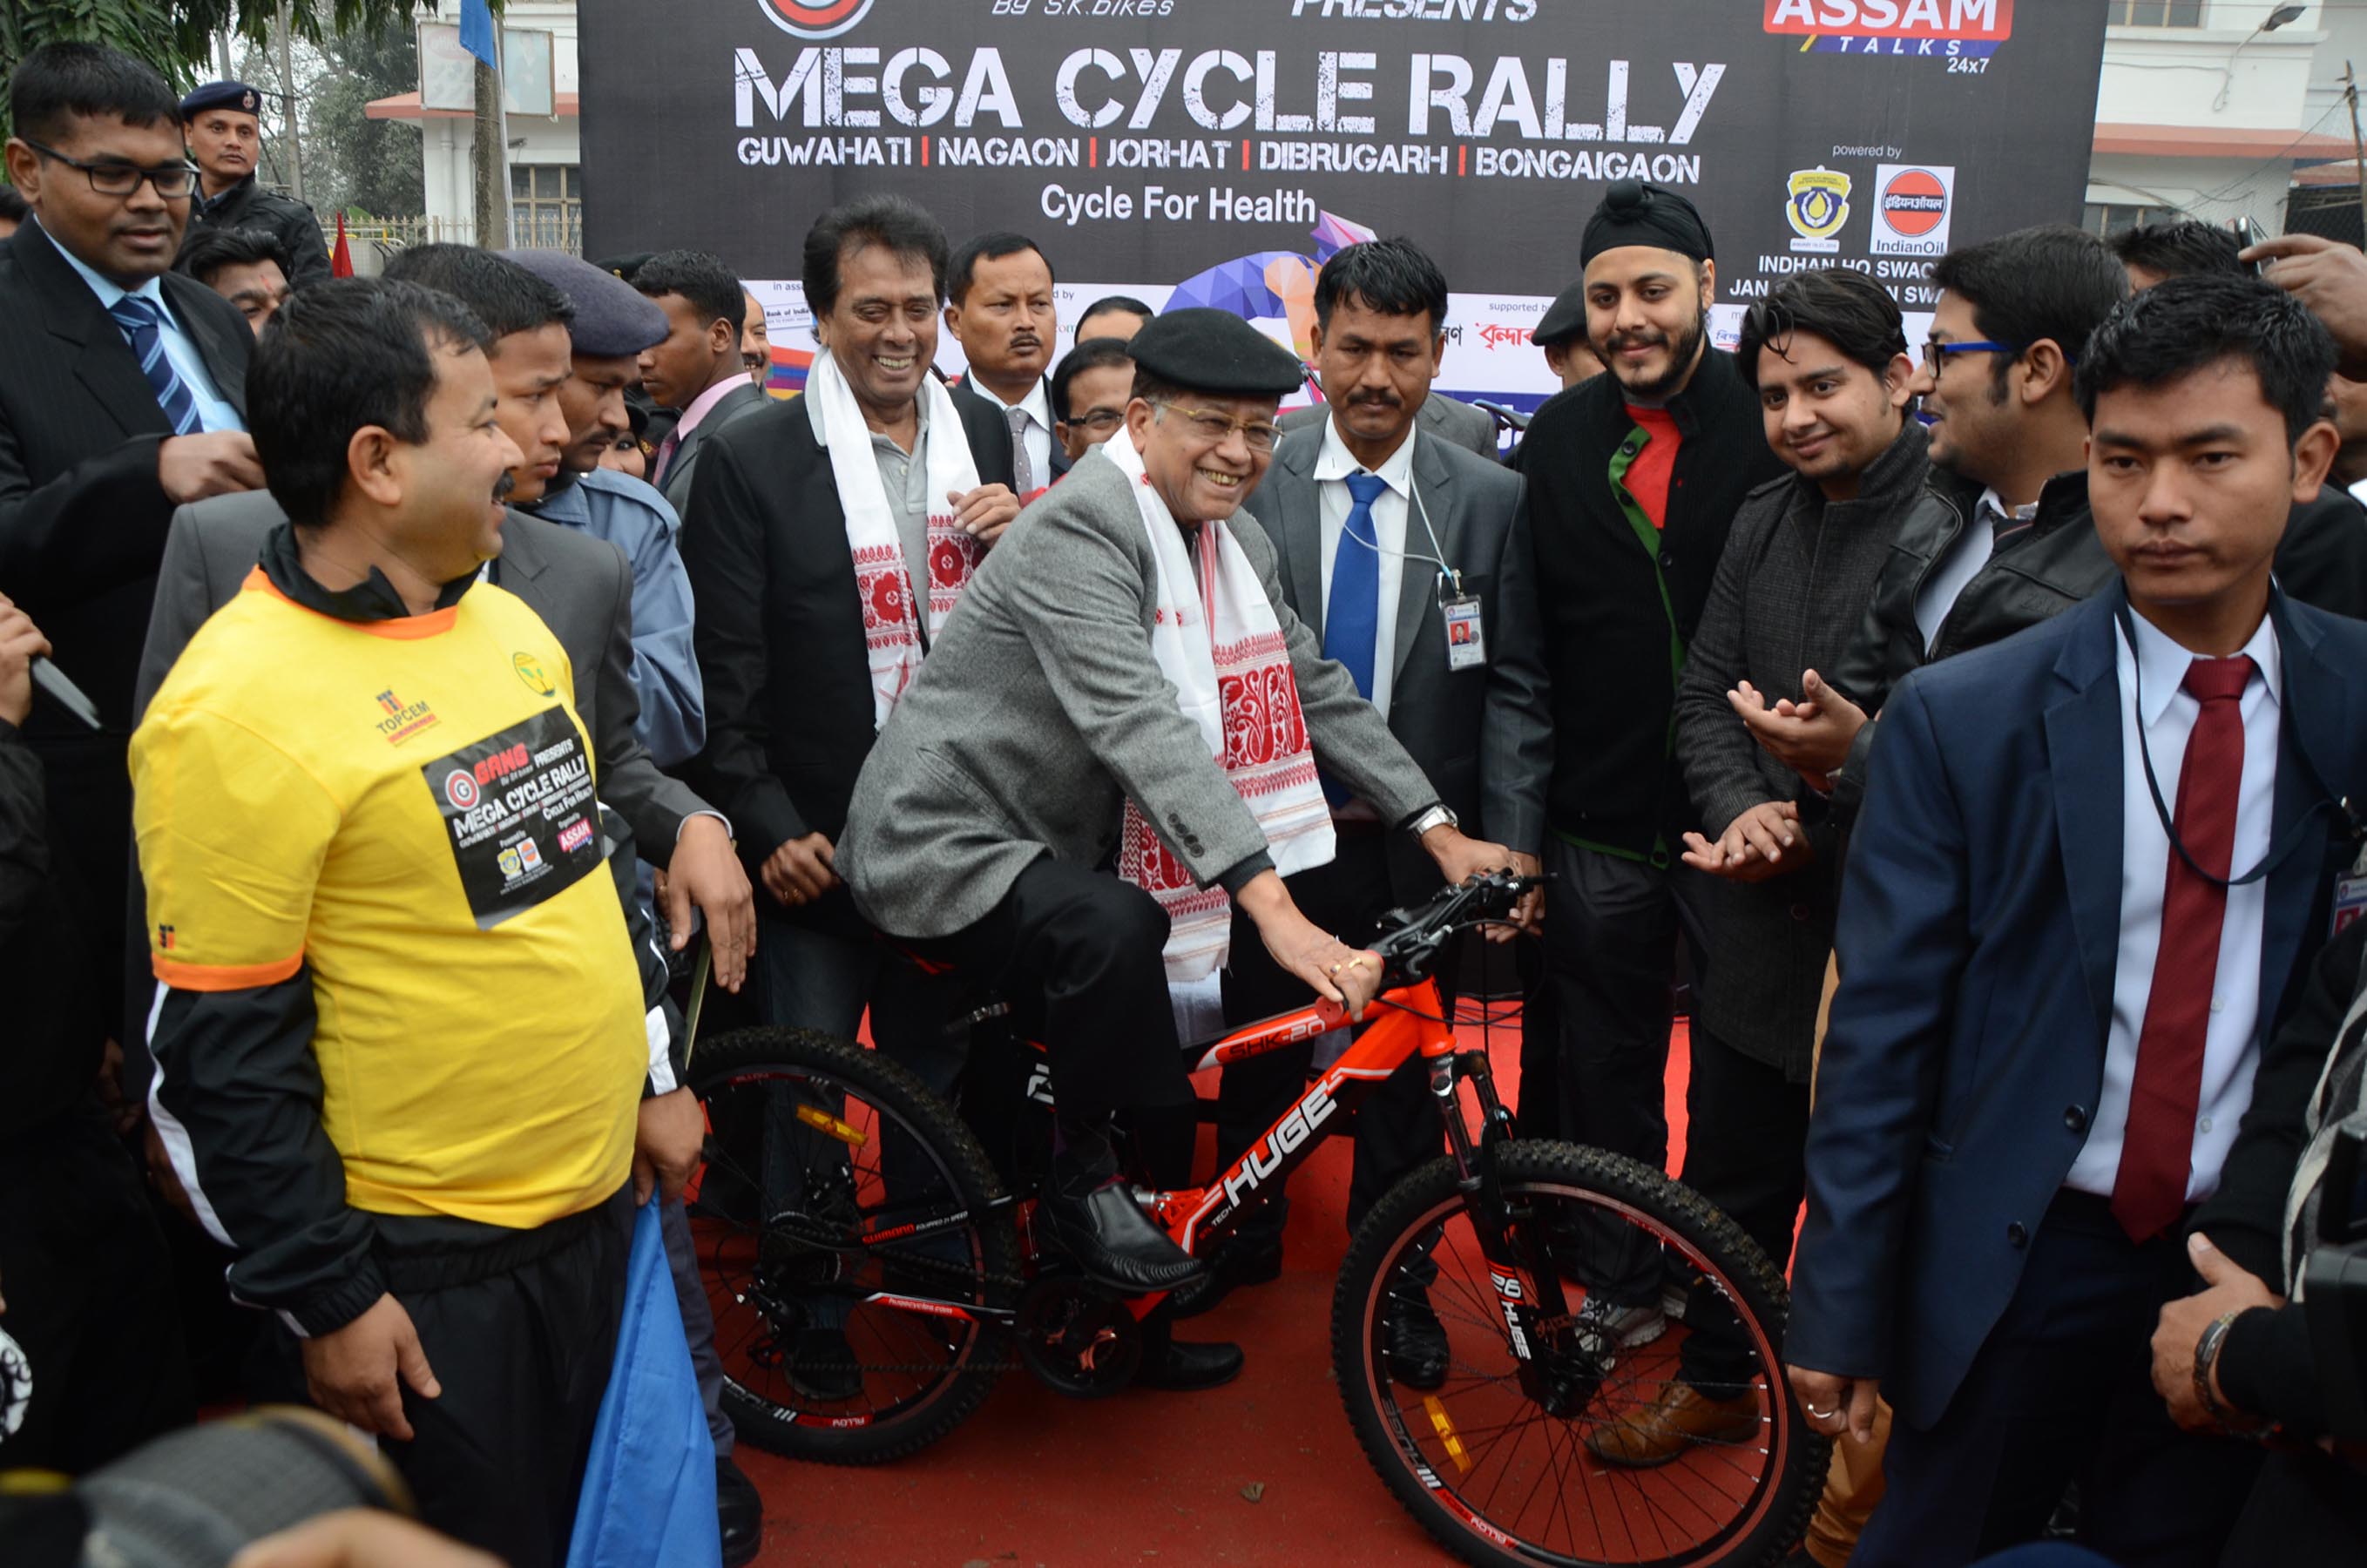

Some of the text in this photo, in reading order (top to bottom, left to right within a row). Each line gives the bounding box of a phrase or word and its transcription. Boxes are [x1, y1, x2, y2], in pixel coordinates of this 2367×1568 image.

[1772, 0, 1998, 32] ASSAM
[1947, 57, 1990, 73] 24x7
[734, 47, 1727, 145] MEGA CYCLE RALLY
[737, 136, 1700, 184] GUWAHATI NAGAON JORHAT DIBRUGARH BONGAIGAON
[1832, 144, 1903, 159] powered by
[1040, 183, 1316, 226] Cycle For Health
[1876, 239, 1945, 255] IndianOil
[1876, 260, 1938, 280] SWAC
[773, 282, 782, 291] in
[1062, 289, 1075, 301] by
[1728, 278, 1769, 298] JAN
[1489, 301, 1539, 313] supported
[375, 700, 431, 734] TOPCEM
[474, 742, 529, 787] GANG
[533, 738, 574, 768] PRESENTS
[453, 798, 510, 839] MEGA
[505, 773, 554, 812] CYCLE
[550, 754, 586, 790] RALLY
[1223, 1080, 1338, 1207] HUGE
[1491, 1270, 1522, 1300] 26
[1500, 1300, 1533, 1361] HUGE
